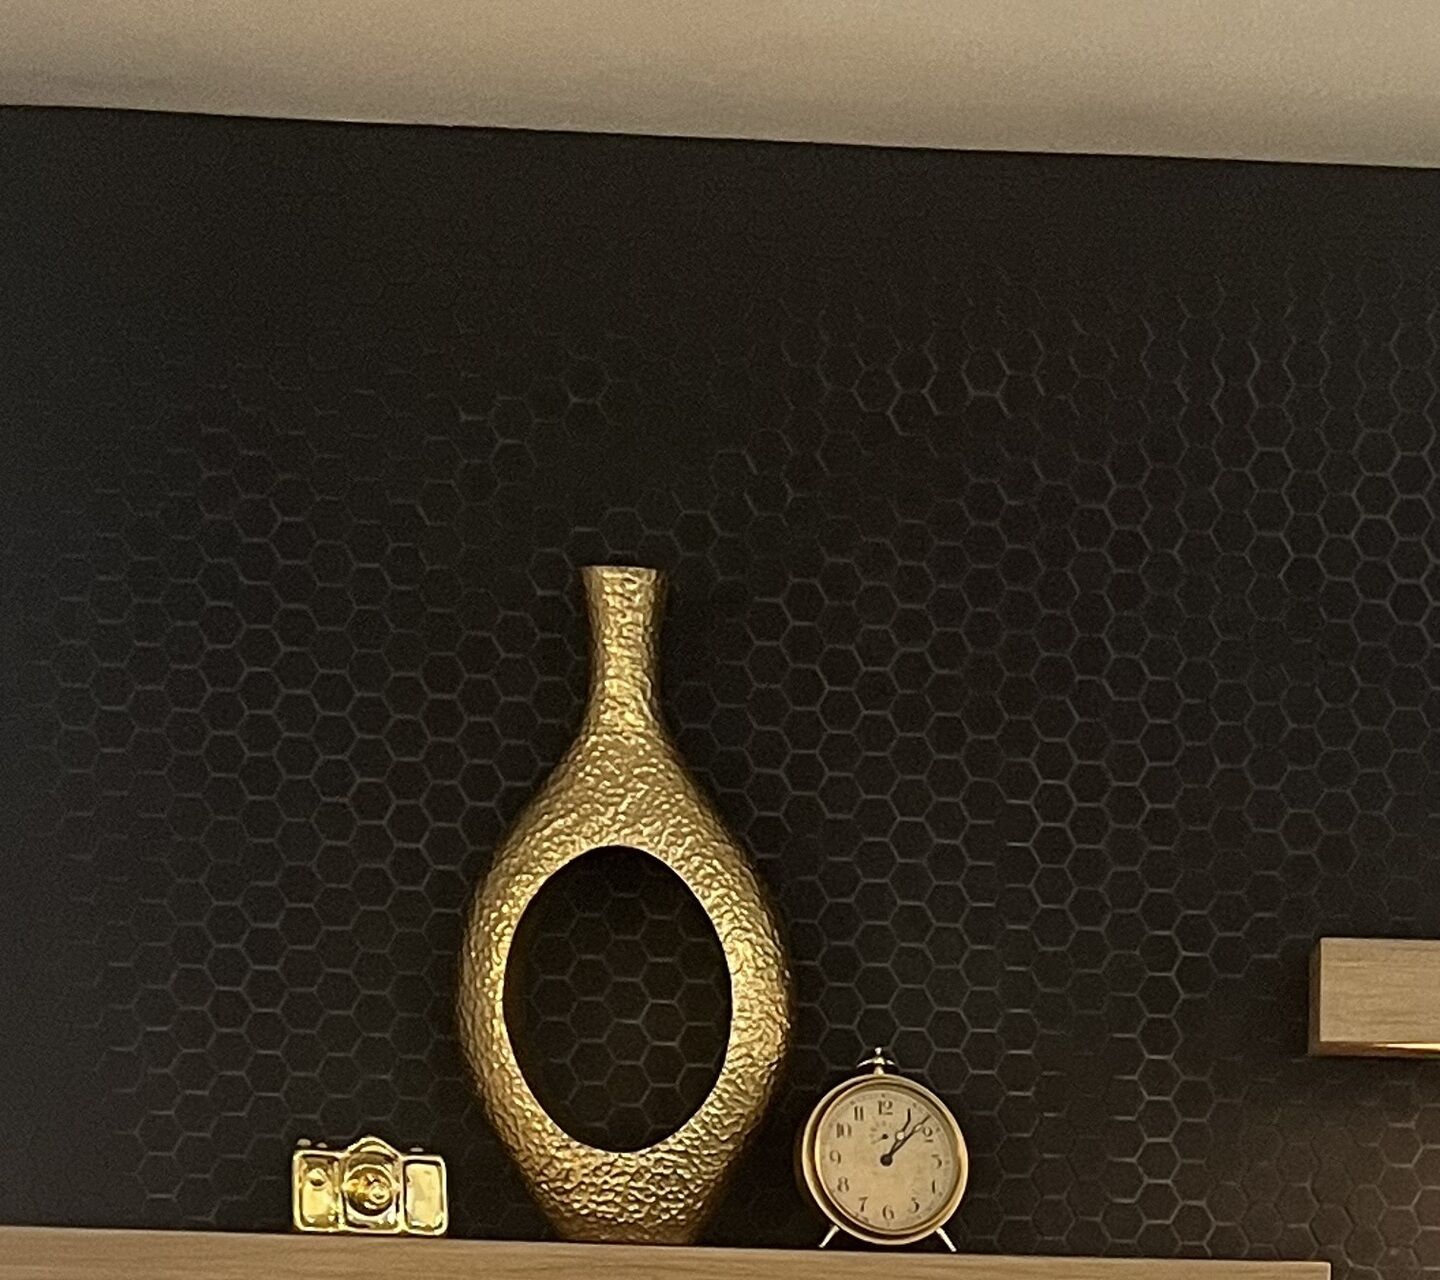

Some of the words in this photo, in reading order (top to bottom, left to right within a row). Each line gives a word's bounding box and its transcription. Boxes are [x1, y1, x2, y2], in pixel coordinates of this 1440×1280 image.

[853, 1105, 864, 1121] 11
[877, 1099, 893, 1115] 12
[836, 1122, 852, 1138] 10
[922, 1126, 934, 1142] 2
[829, 1150, 842, 1164] 9
[837, 1177, 850, 1192] 8
[858, 1196, 868, 1212] 7
[882, 1204, 895, 1220] 6
